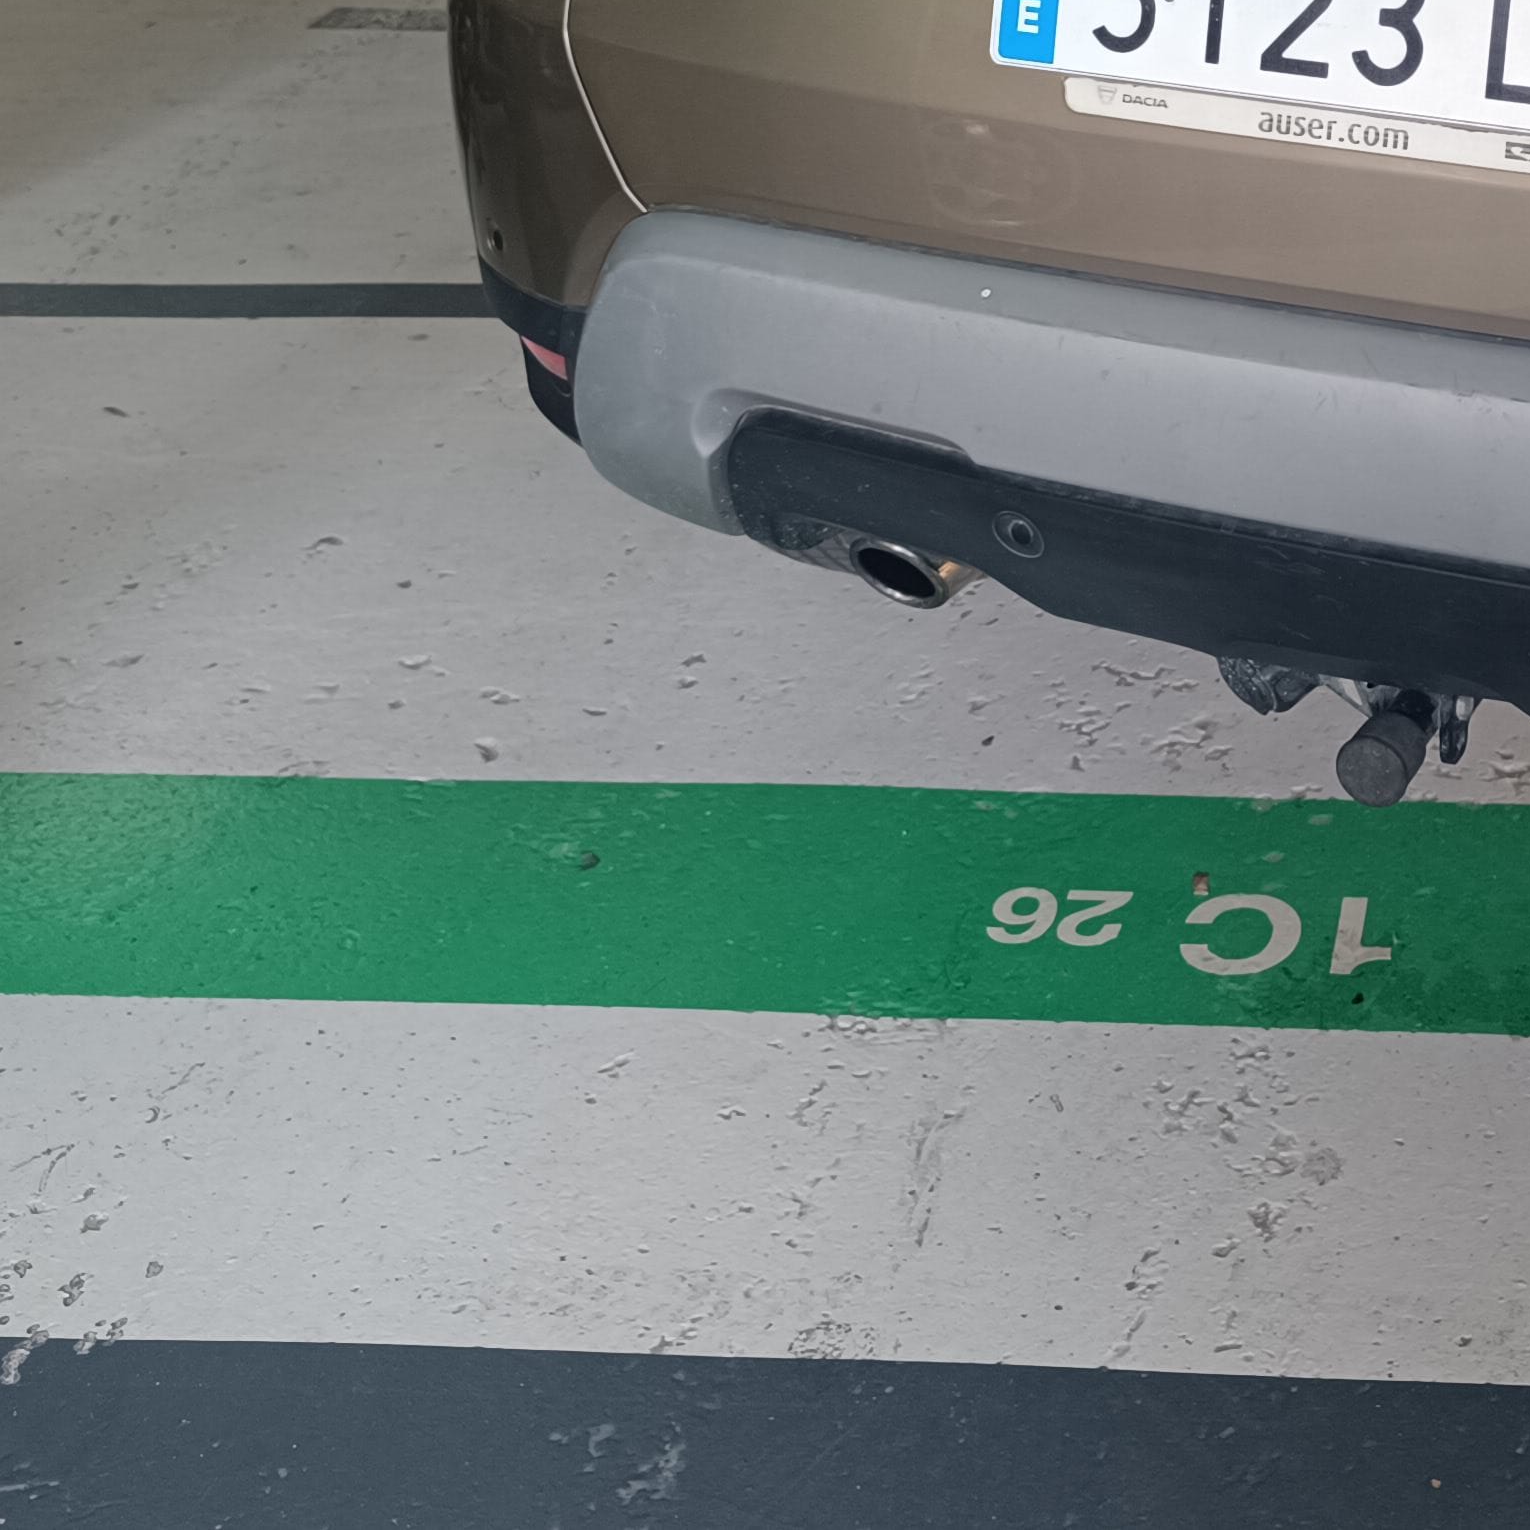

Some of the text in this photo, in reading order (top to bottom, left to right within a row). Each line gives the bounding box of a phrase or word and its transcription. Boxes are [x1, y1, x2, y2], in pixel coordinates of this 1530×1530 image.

[1121, 93, 1169, 110] DACIA
[1257, 110, 1411, 152] auser.com
[985, 886, 1392, 976] 1C 26
